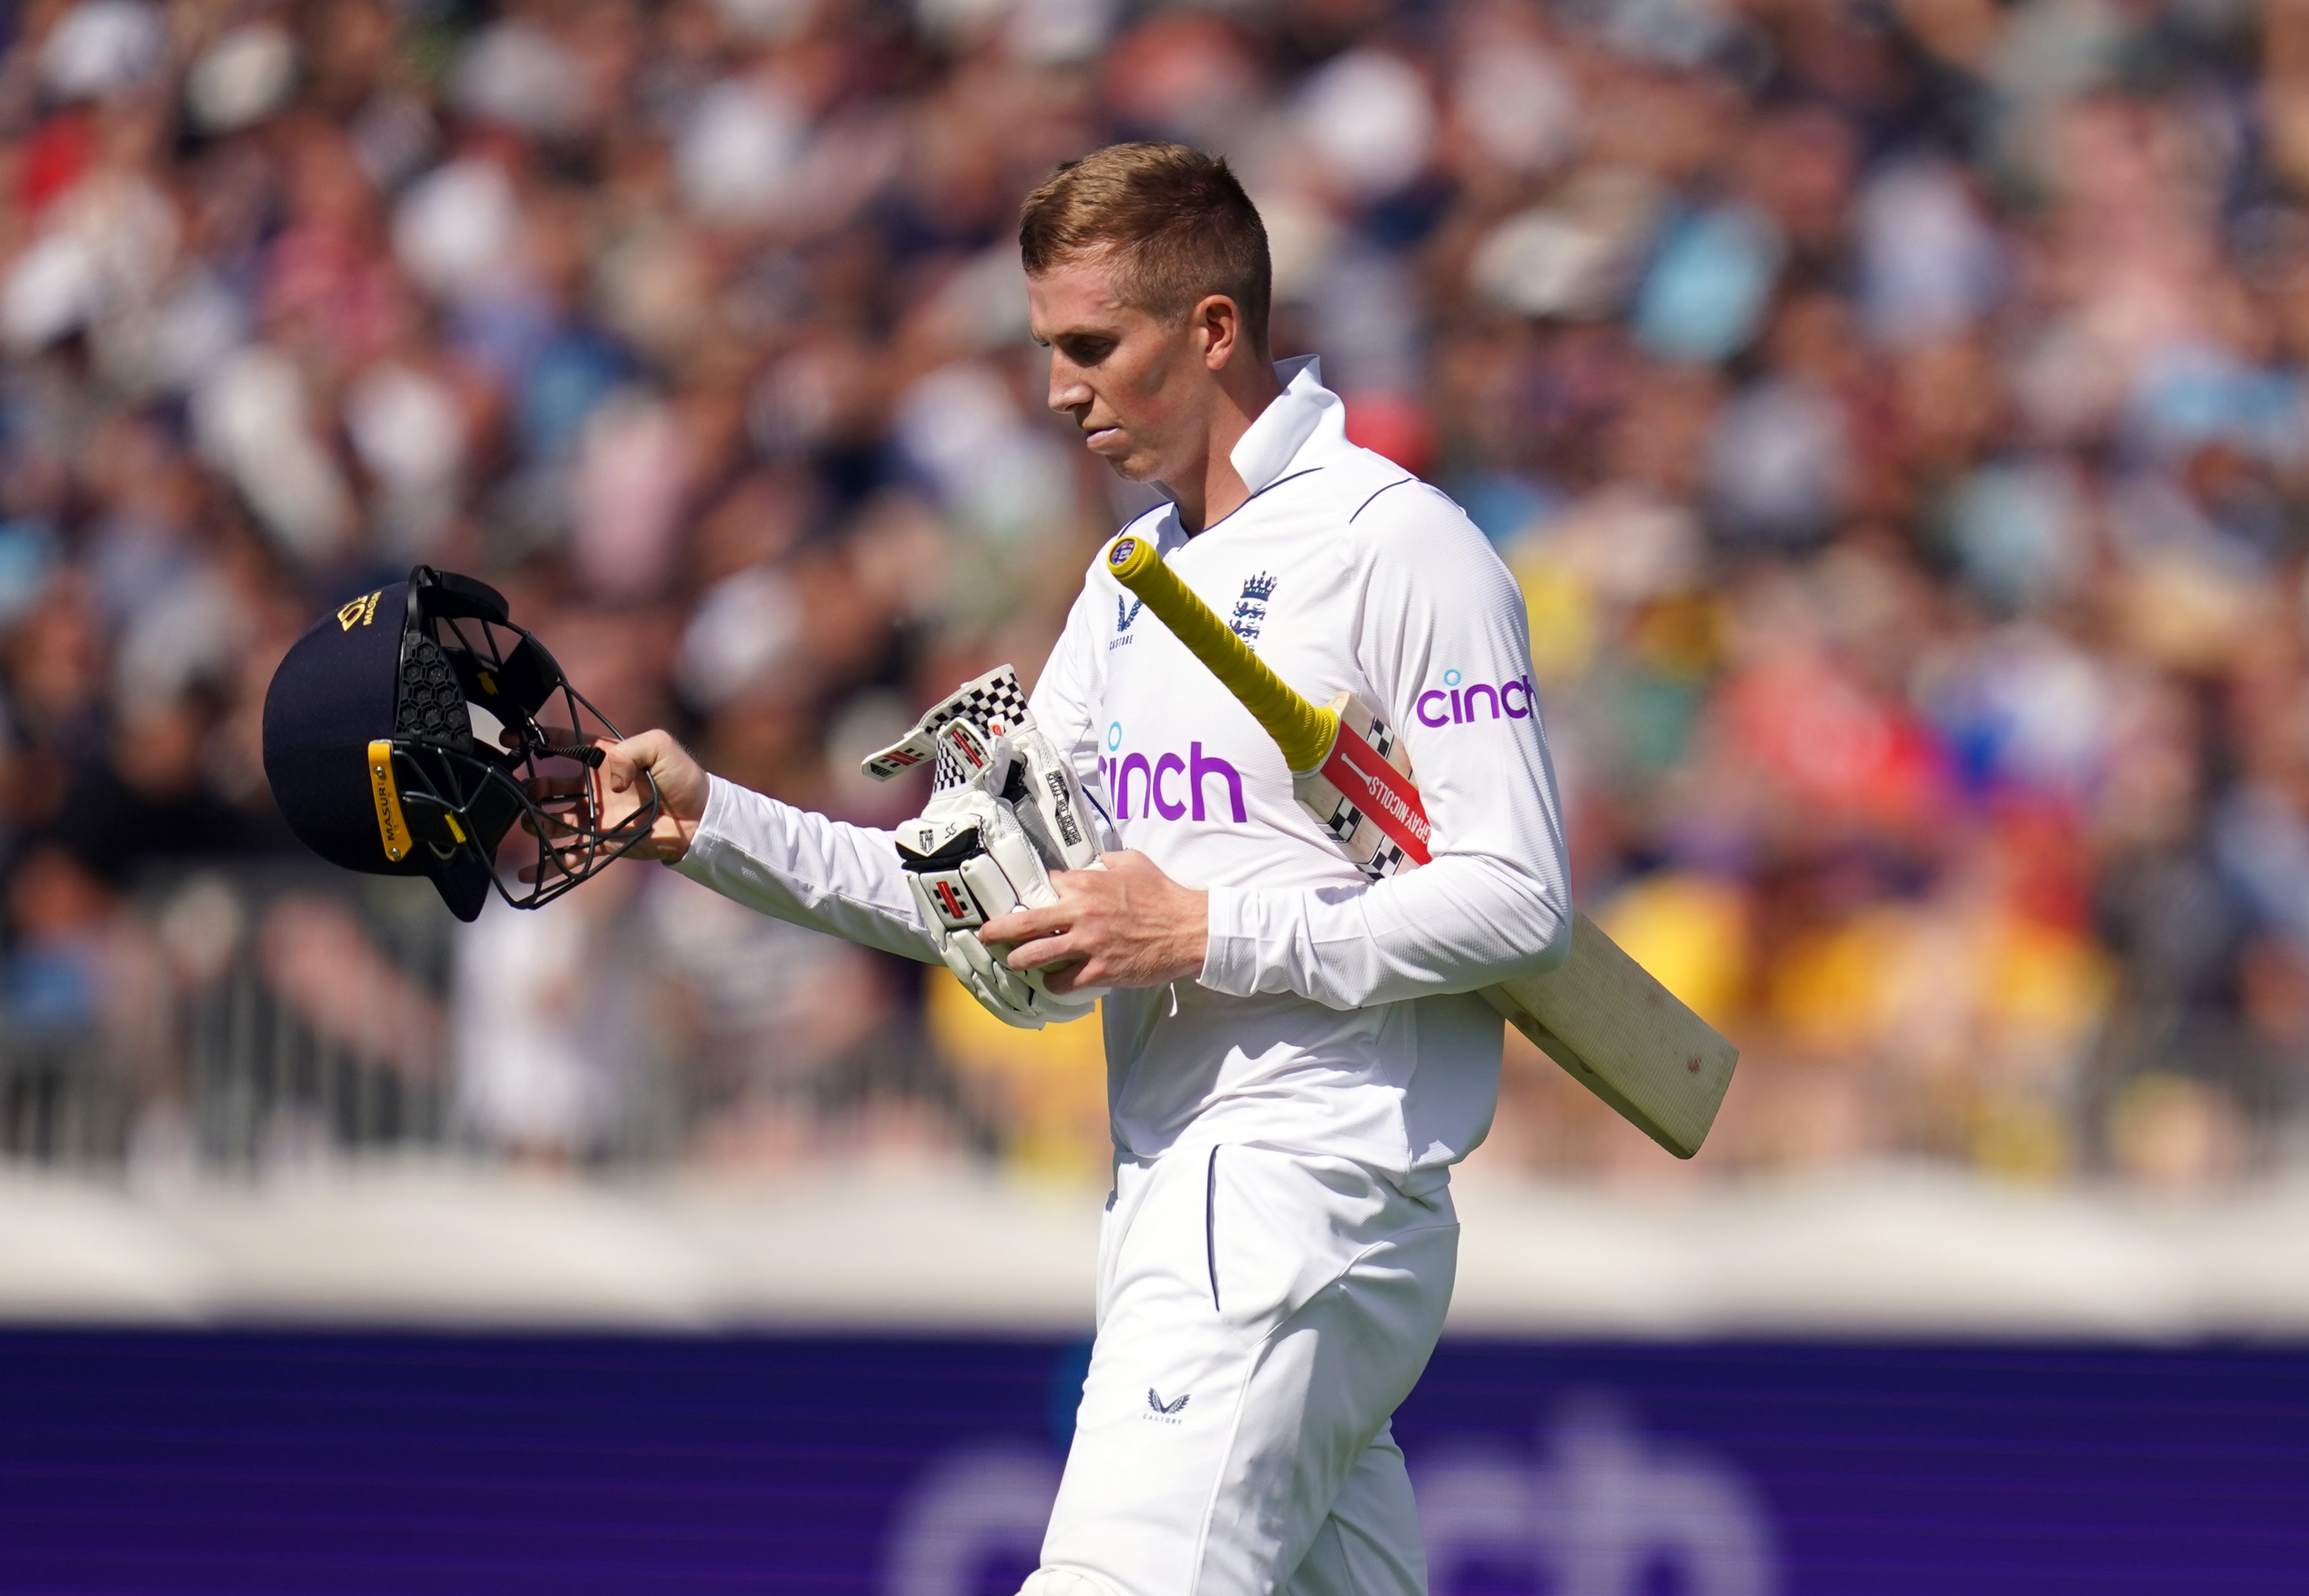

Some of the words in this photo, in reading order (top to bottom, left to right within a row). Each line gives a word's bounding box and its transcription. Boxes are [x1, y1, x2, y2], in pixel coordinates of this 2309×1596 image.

[1109, 634, 1134, 651] CASTORE
[1417, 669, 1537, 728] cinch
[378, 782, 395, 841] MASURI
[1143, 1413, 1182, 1425] CASTORE
